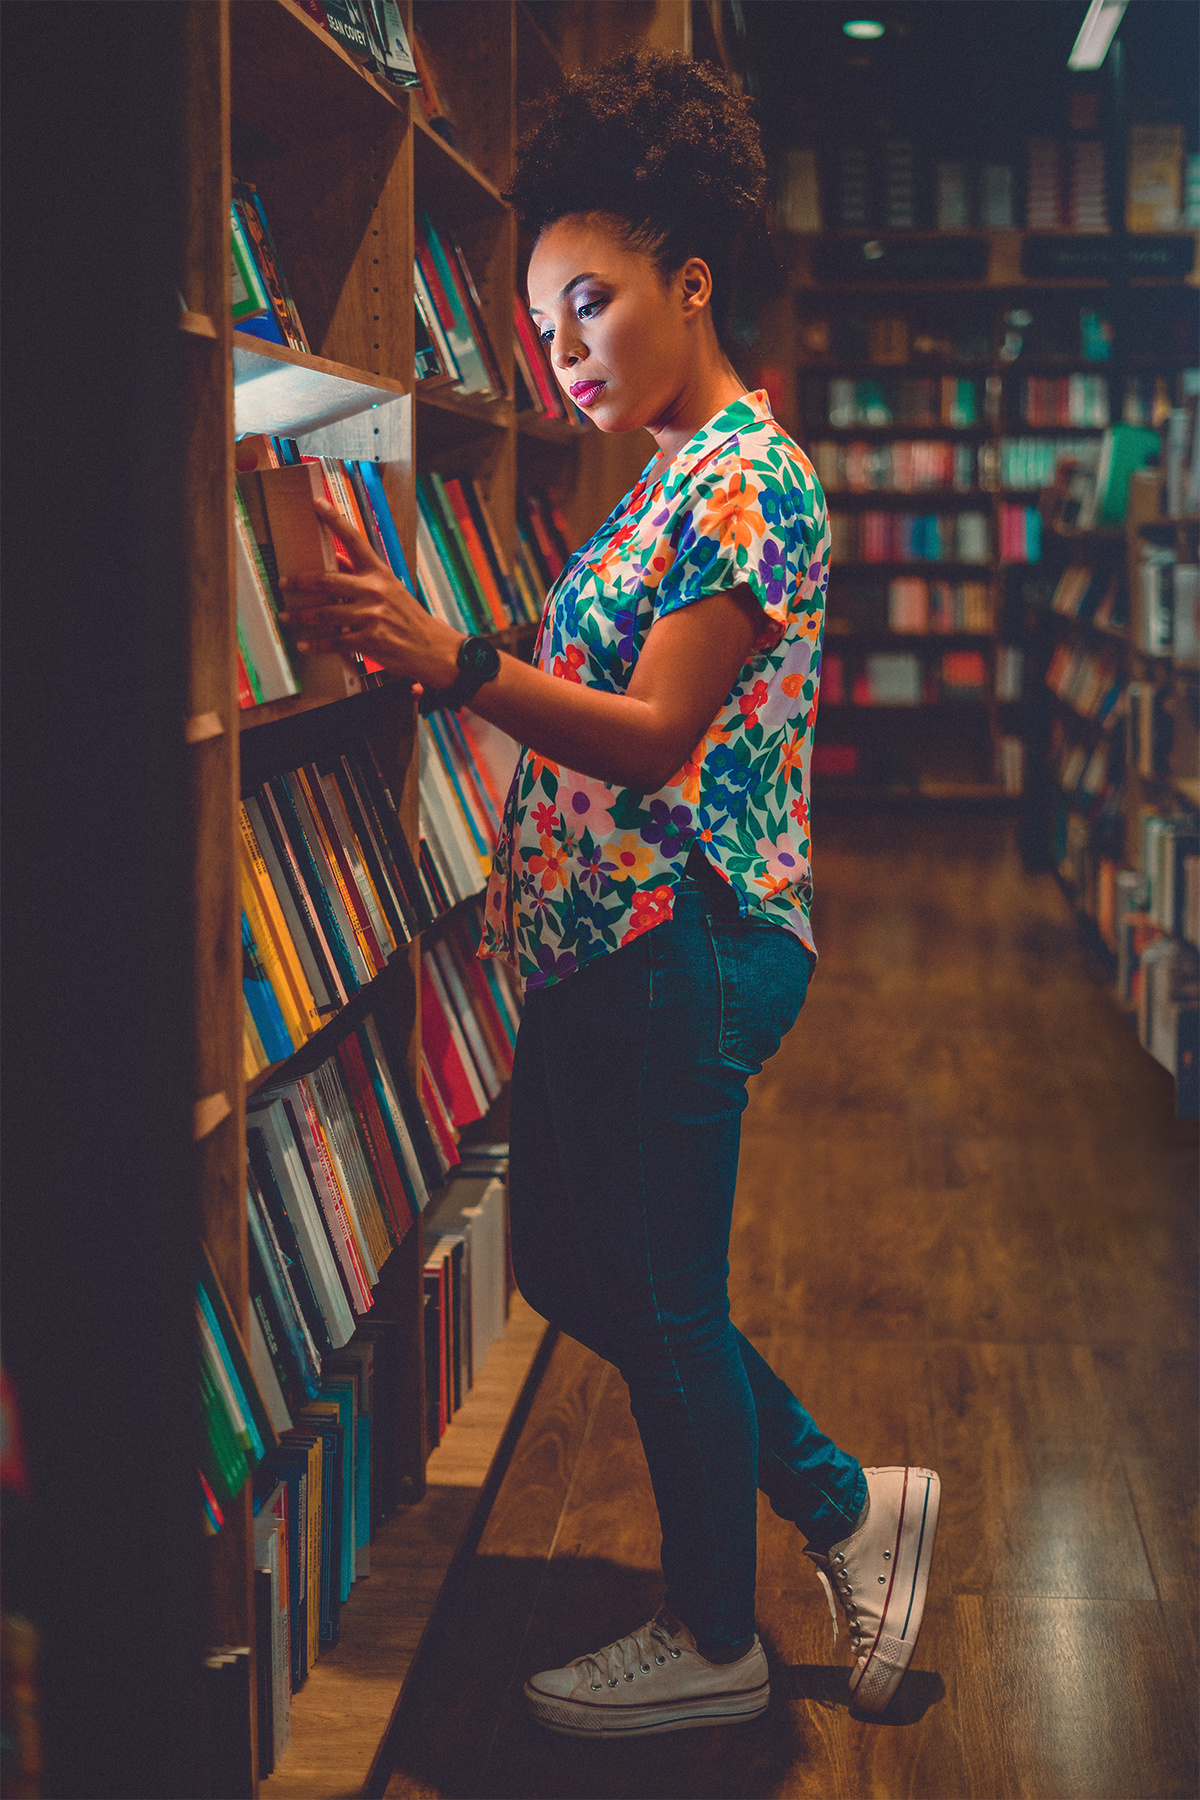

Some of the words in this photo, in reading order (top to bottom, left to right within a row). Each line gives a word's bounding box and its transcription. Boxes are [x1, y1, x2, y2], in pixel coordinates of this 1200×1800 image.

[326, 13, 346, 36] SEAN
[344, 23, 367, 47] COVEY
[244, 832, 263, 875] CARNEGIE
[315, 1145, 329, 1178] FEITAS
[325, 1179, 339, 1206] PARA
[335, 1208, 349, 1241] DURAR
[319, 1140, 333, 1173] FEITAS
[330, 1174, 342, 1202] PARA
[339, 1203, 353, 1236] DURAR
